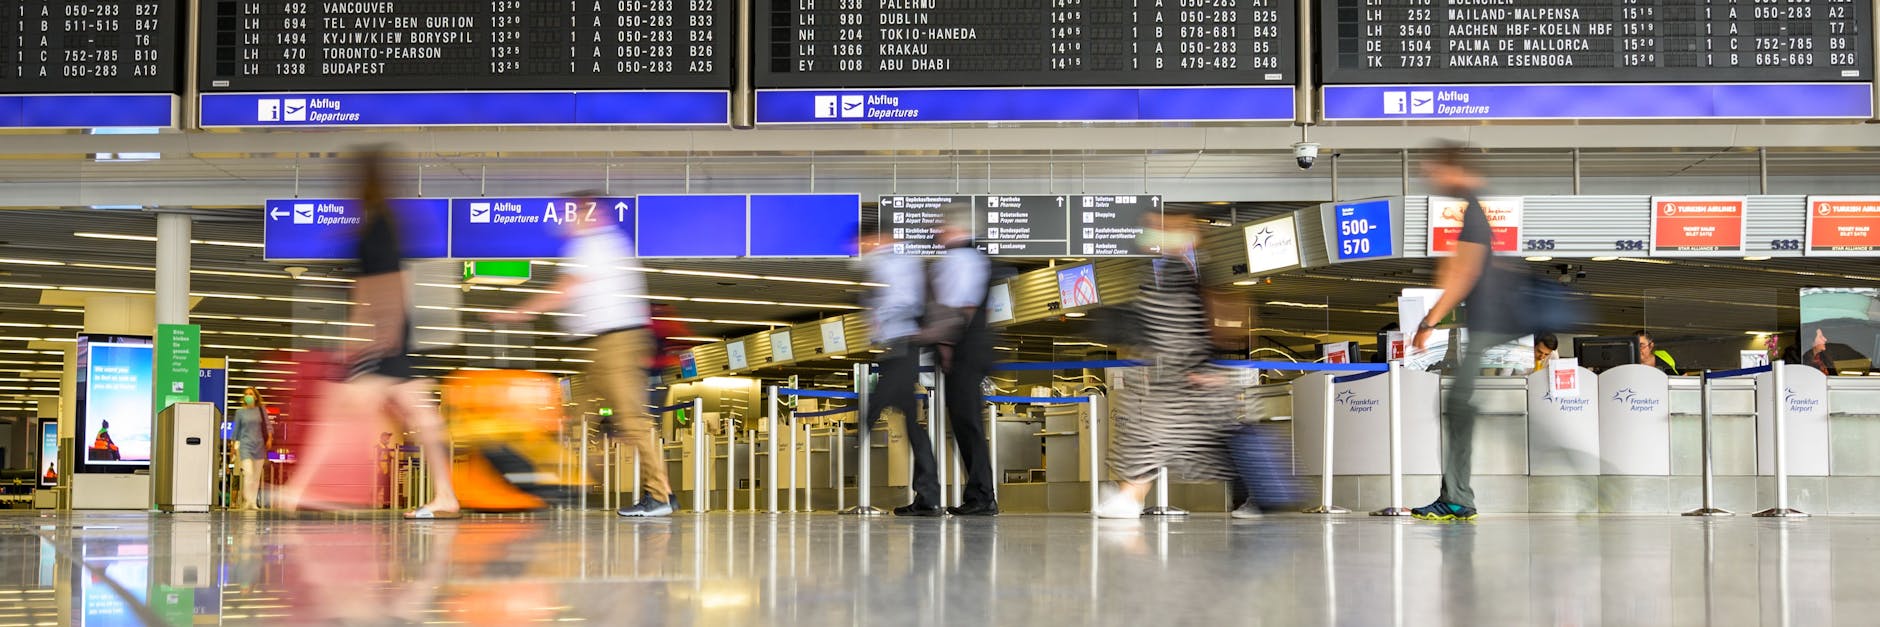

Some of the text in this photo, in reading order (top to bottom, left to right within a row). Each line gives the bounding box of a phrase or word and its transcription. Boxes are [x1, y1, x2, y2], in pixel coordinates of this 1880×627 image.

[66, 5, 157, 16] 050-283 B27
[245, 4, 259, 14] LH
[285, 3, 306, 13] 492
[324, 2, 393, 13] VANCOUVER
[1367, 10, 1381, 20] LH
[1409, 10, 1430, 20] 252
[1449, 8, 1579, 20] MAILAND-MALPENSA
[1755, 7, 1811, 18] 050-283
[1829, 7, 1844, 17] A2
[245, 19, 259, 29] LH
[285, 18, 306, 29] 694
[324, 18, 345, 28] TEL
[355, 17, 417, 28] AVIV-BEN
[427, 17, 473, 28] GURION
[618, 16, 672, 26] 050-283
[690, 15, 712, 26] B33
[800, 14, 814, 25] LH
[840, 14, 862, 24] 980
[880, 13, 927, 24] DUBLIN
[1181, 11, 1236, 22] 050-283
[1254, 11, 1276, 22] B25
[65, 20, 157, 31] 511-515 B47
[1368, 25, 1381, 36] LH
[1400, 25, 1430, 36] 3540
[1449, 24, 1497, 35] AACHEN
[1507, 24, 1579, 35] HBF-KOELN
[1589, 24, 1612, 34] HBF
[1830, 22, 1844, 33] T7
[245, 34, 258, 44] LH
[278, 33, 305, 44] 1494
[324, 33, 401, 43] KYJIW/KIEW
[411, 32, 472, 43] BORYSPIL
[619, 31, 672, 42] 050-283
[690, 31, 712, 41] B24
[799, 30, 814, 40] NH
[840, 29, 862, 40] 204
[881, 28, 976, 40] TOKIO-HANEDA
[1181, 27, 1235, 37] 678-681
[1254, 26, 1276, 37] B43
[136, 35, 149, 45] T6
[1367, 41, 1381, 51] DE
[1402, 40, 1431, 51] 1504
[1450, 40, 1489, 50] PALMA
[1499, 40, 1513, 50] DE
[1524, 39, 1589, 50] MALLORCA
[1756, 38, 1812, 49] 752-785
[1831, 38, 1845, 49] B9
[244, 49, 258, 59] LH
[284, 48, 305, 59] 470
[323, 47, 440, 59] TORONTO-PEARSON
[618, 46, 672, 57] 050-283
[690, 46, 712, 56] B26
[800, 45, 814, 55] LH
[833, 44, 862, 55] 1366
[880, 44, 927, 55] KRAKAU
[1181, 42, 1236, 53] 050-283
[1254, 42, 1268, 52] B5
[65, 50, 157, 61] 752-785 B10
[1368, 56, 1382, 66] TK
[1401, 56, 1431, 66] 7737
[1450, 55, 1498, 66] ANKARA
[1508, 55, 1572, 66] ESENBOGA
[1757, 54, 1812, 65] 665-669
[1831, 54, 1853, 64] B26
[245, 64, 258, 74] LH
[277, 64, 305, 74] 1338
[323, 63, 384, 74] BUDAPEST
[618, 61, 672, 72] 050-283
[690, 61, 712, 72] A25
[800, 60, 813, 71] EY
[840, 60, 862, 70] 008
[880, 60, 902, 70] ABU
[913, 59, 949, 70] DHABI
[1181, 57, 1236, 68] 479-482
[1255, 57, 1276, 68] B48
[64, 65, 156, 76] 050-283 A18
[868, 95, 898, 106] Abflug
[1437, 91, 1469, 103] Abflug
[310, 99, 340, 110] Abflug
[1438, 104, 1489, 115] Departures
[310, 111, 359, 123] Departures
[868, 108, 918, 119] Departures
[317, 204, 343, 214] Abflug
[494, 203, 521, 213] Abflug
[317, 215, 360, 225] Departures
[494, 214, 539, 224] Departures
[1342, 219, 1376, 235] 500-
[1344, 238, 1370, 255] 570
[1527, 240, 1555, 250] 535
[1616, 240, 1643, 250] 534
[1771, 240, 1799, 250] 533
